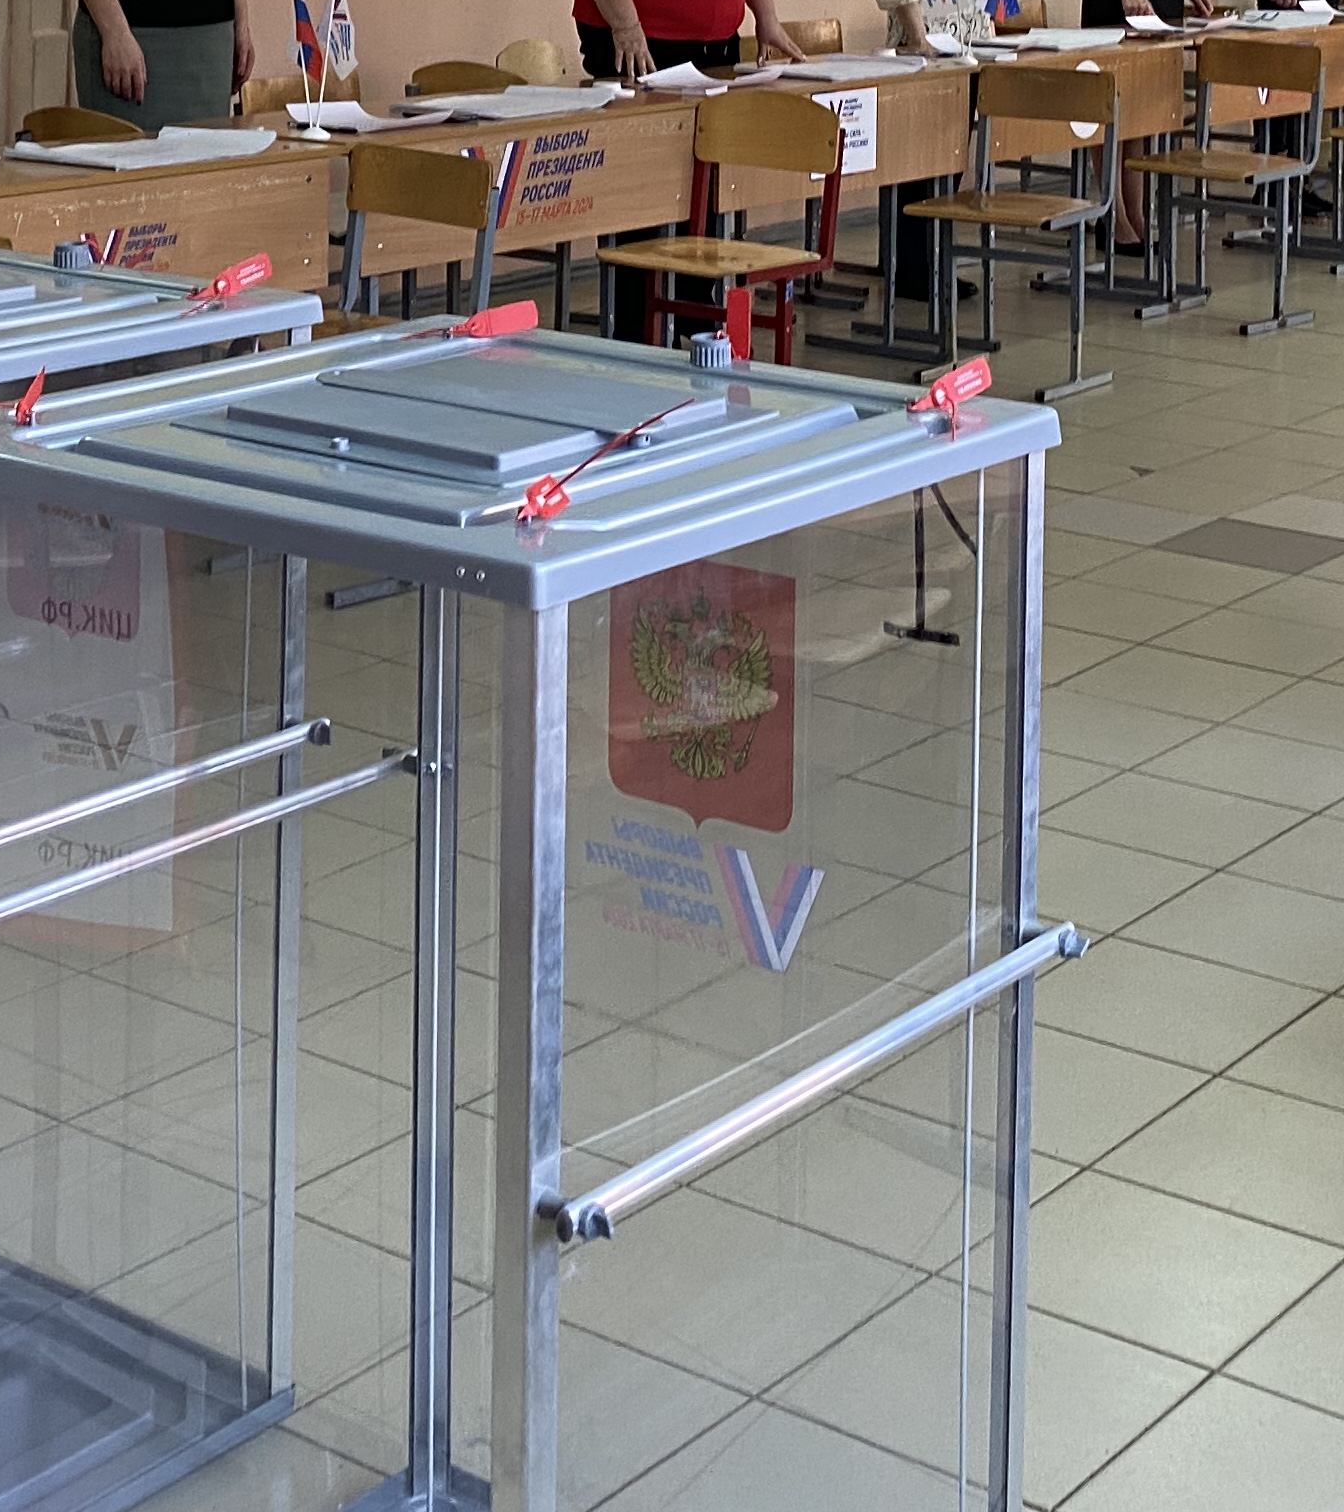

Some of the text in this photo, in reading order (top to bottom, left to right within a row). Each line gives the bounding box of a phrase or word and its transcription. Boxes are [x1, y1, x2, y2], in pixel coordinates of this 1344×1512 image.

[533, 128, 590, 155] ВЫБОРЫ
[526, 149, 605, 180] ПРЕЗИДЕНТА
[520, 178, 572, 205] РОССИИ
